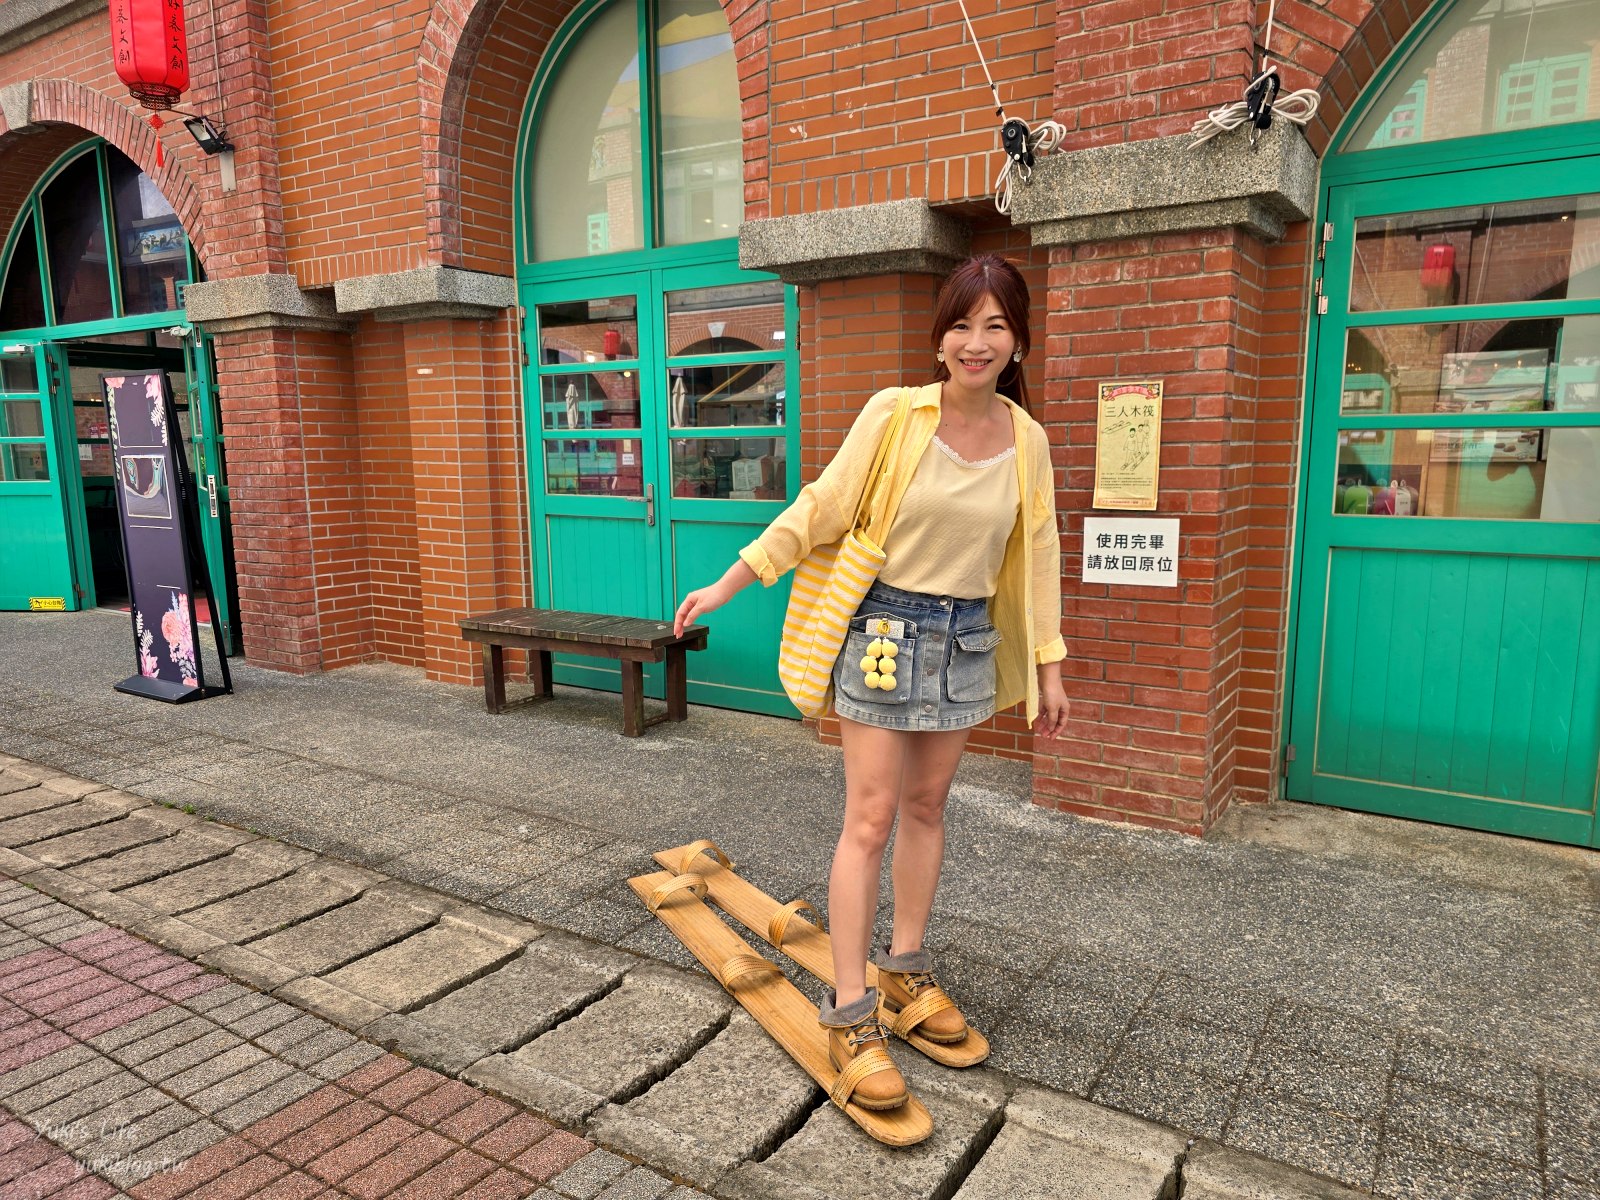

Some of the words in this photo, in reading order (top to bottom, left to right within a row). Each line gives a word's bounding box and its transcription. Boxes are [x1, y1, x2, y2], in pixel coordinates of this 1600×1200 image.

[1104, 404, 1154, 417] 三人木筏
[1096, 532, 1165, 550] 使用完畢
[1087, 554, 1173, 573] 請放回原位
